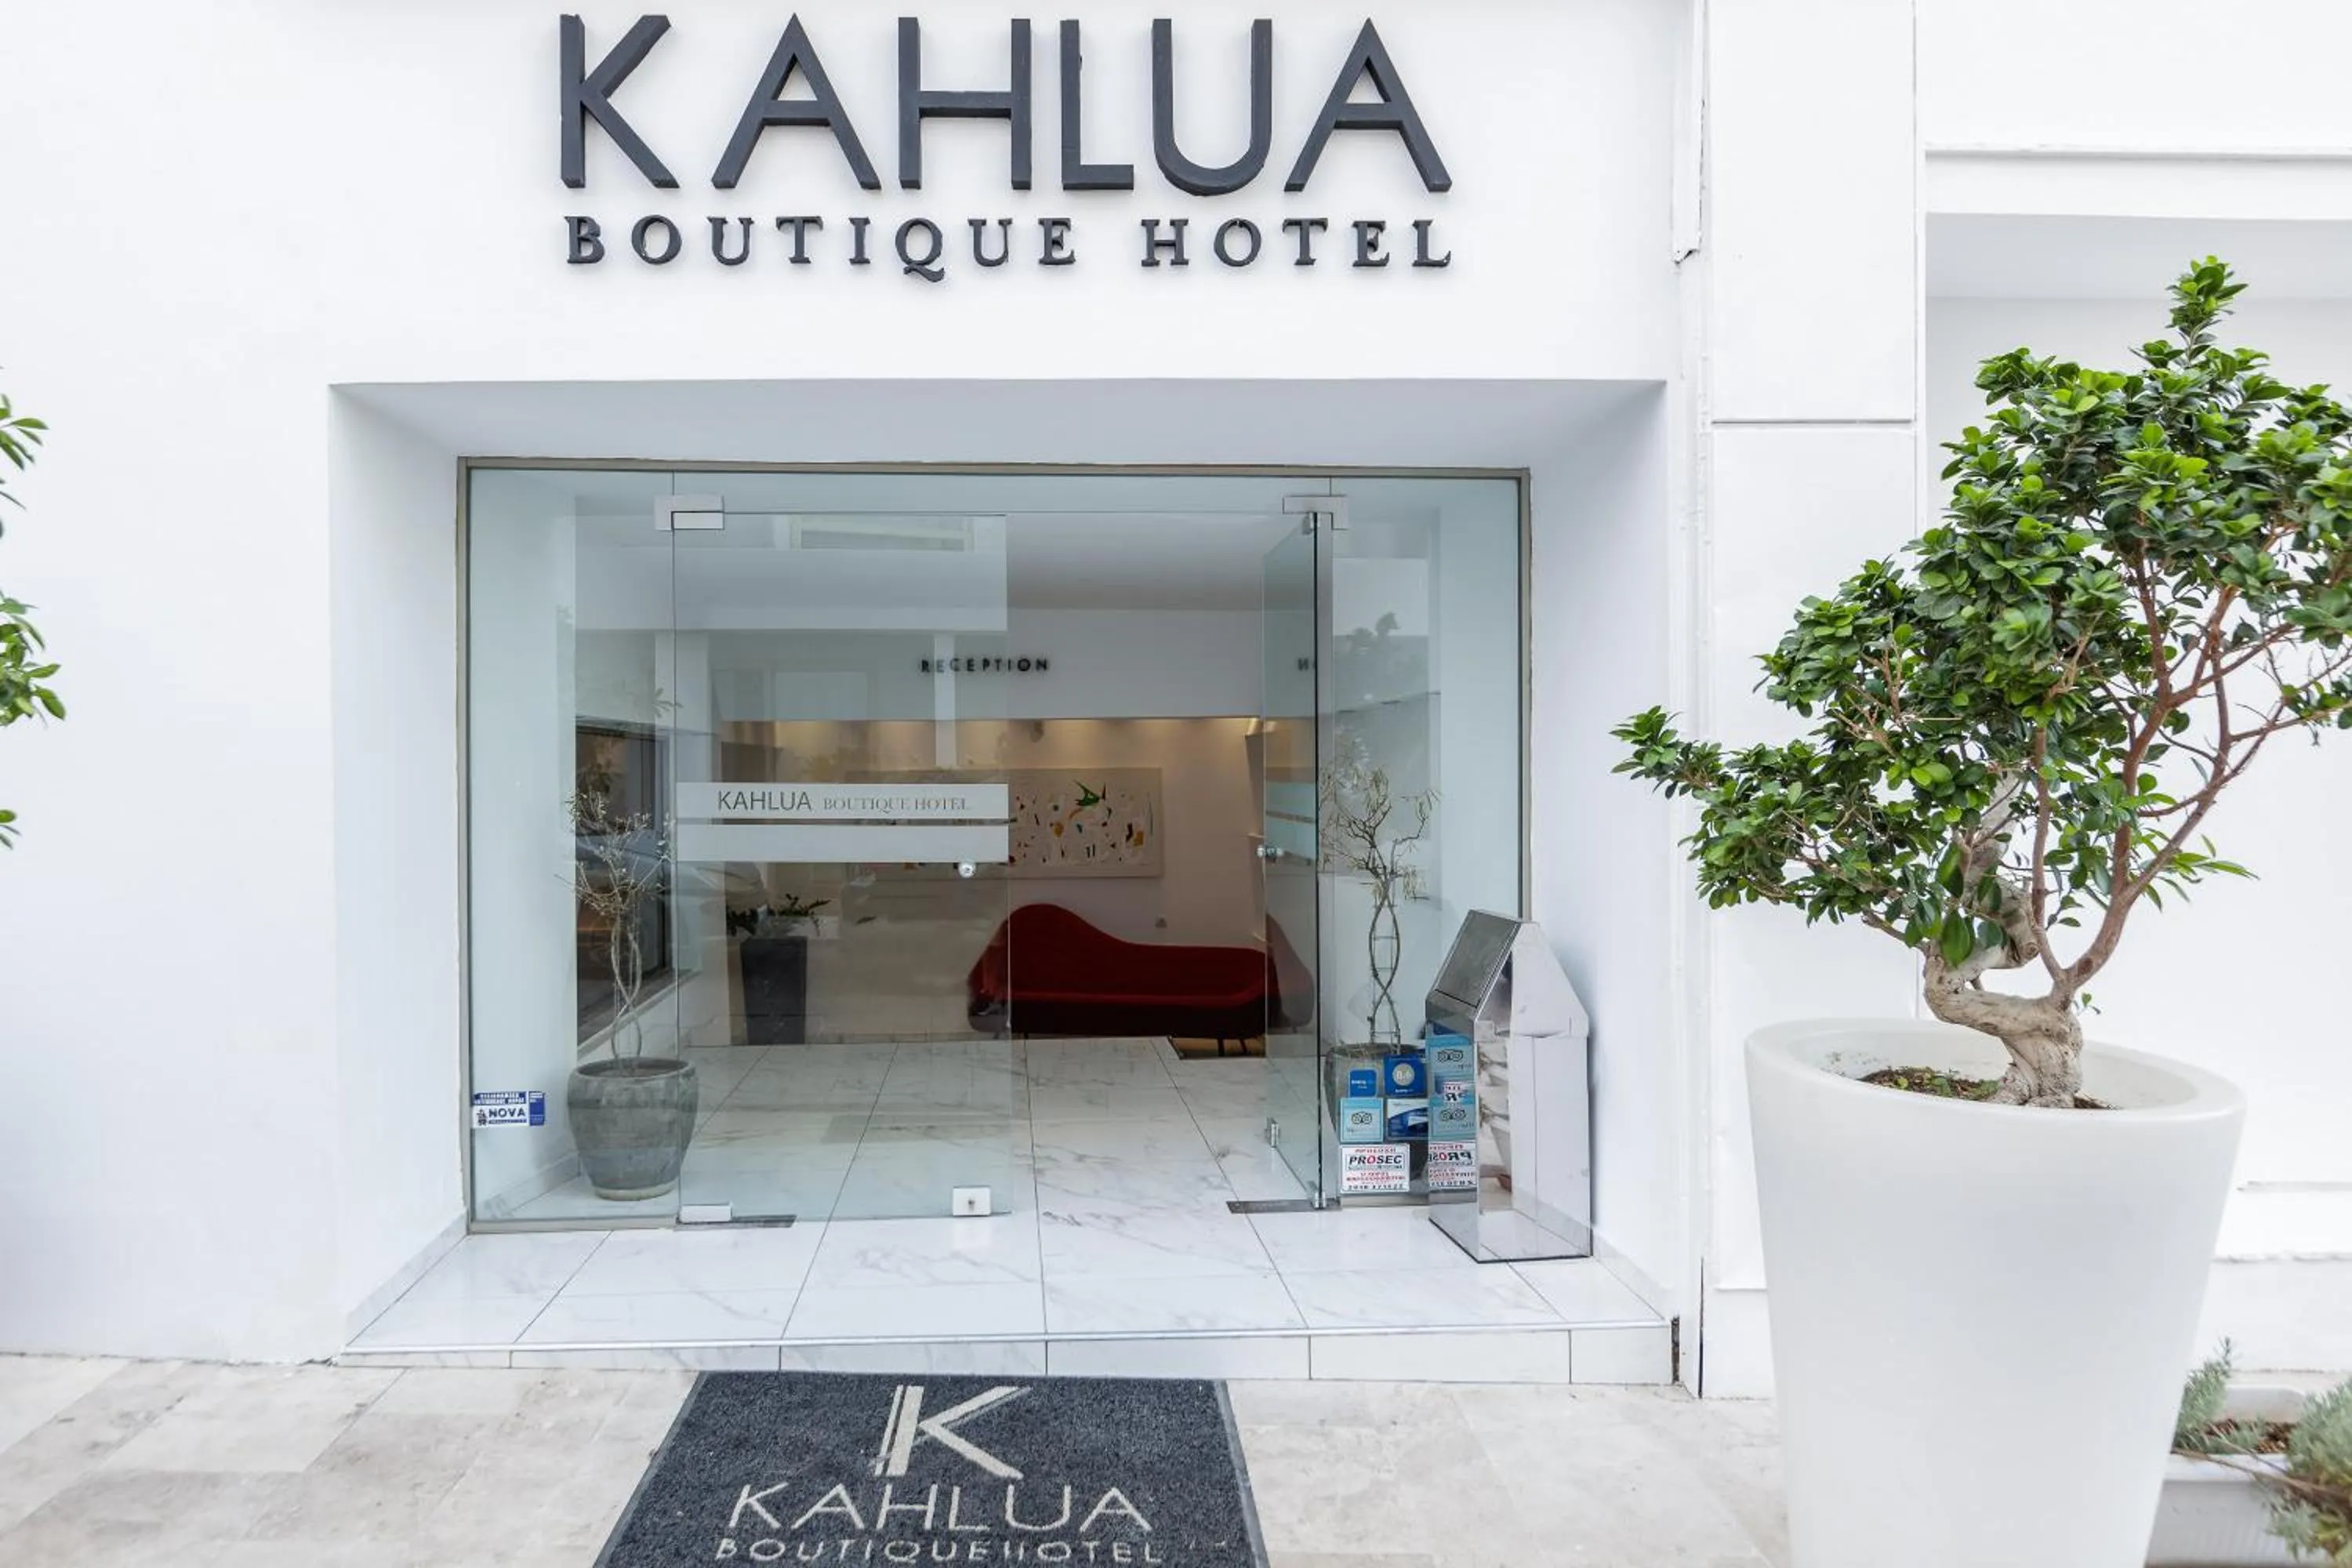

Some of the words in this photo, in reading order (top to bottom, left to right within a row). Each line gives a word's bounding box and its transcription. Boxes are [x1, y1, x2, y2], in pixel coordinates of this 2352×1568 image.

[560, 13, 1453, 198] KAHLUA
[563, 213, 1077, 283] BOUTIQUE
[1139, 216, 1452, 269] HOTEL
[920, 656, 1049, 673] RECEPTION
[717, 789, 812, 811] KAHLUA
[823, 797, 906, 815] BOUTIQUE
[914, 797, 969, 811] HOTEL
[488, 1108, 526, 1118] NOVA
[1349, 1155, 1403, 1164] PROSEC
[728, 1481, 1152, 1533] KAHLUA
